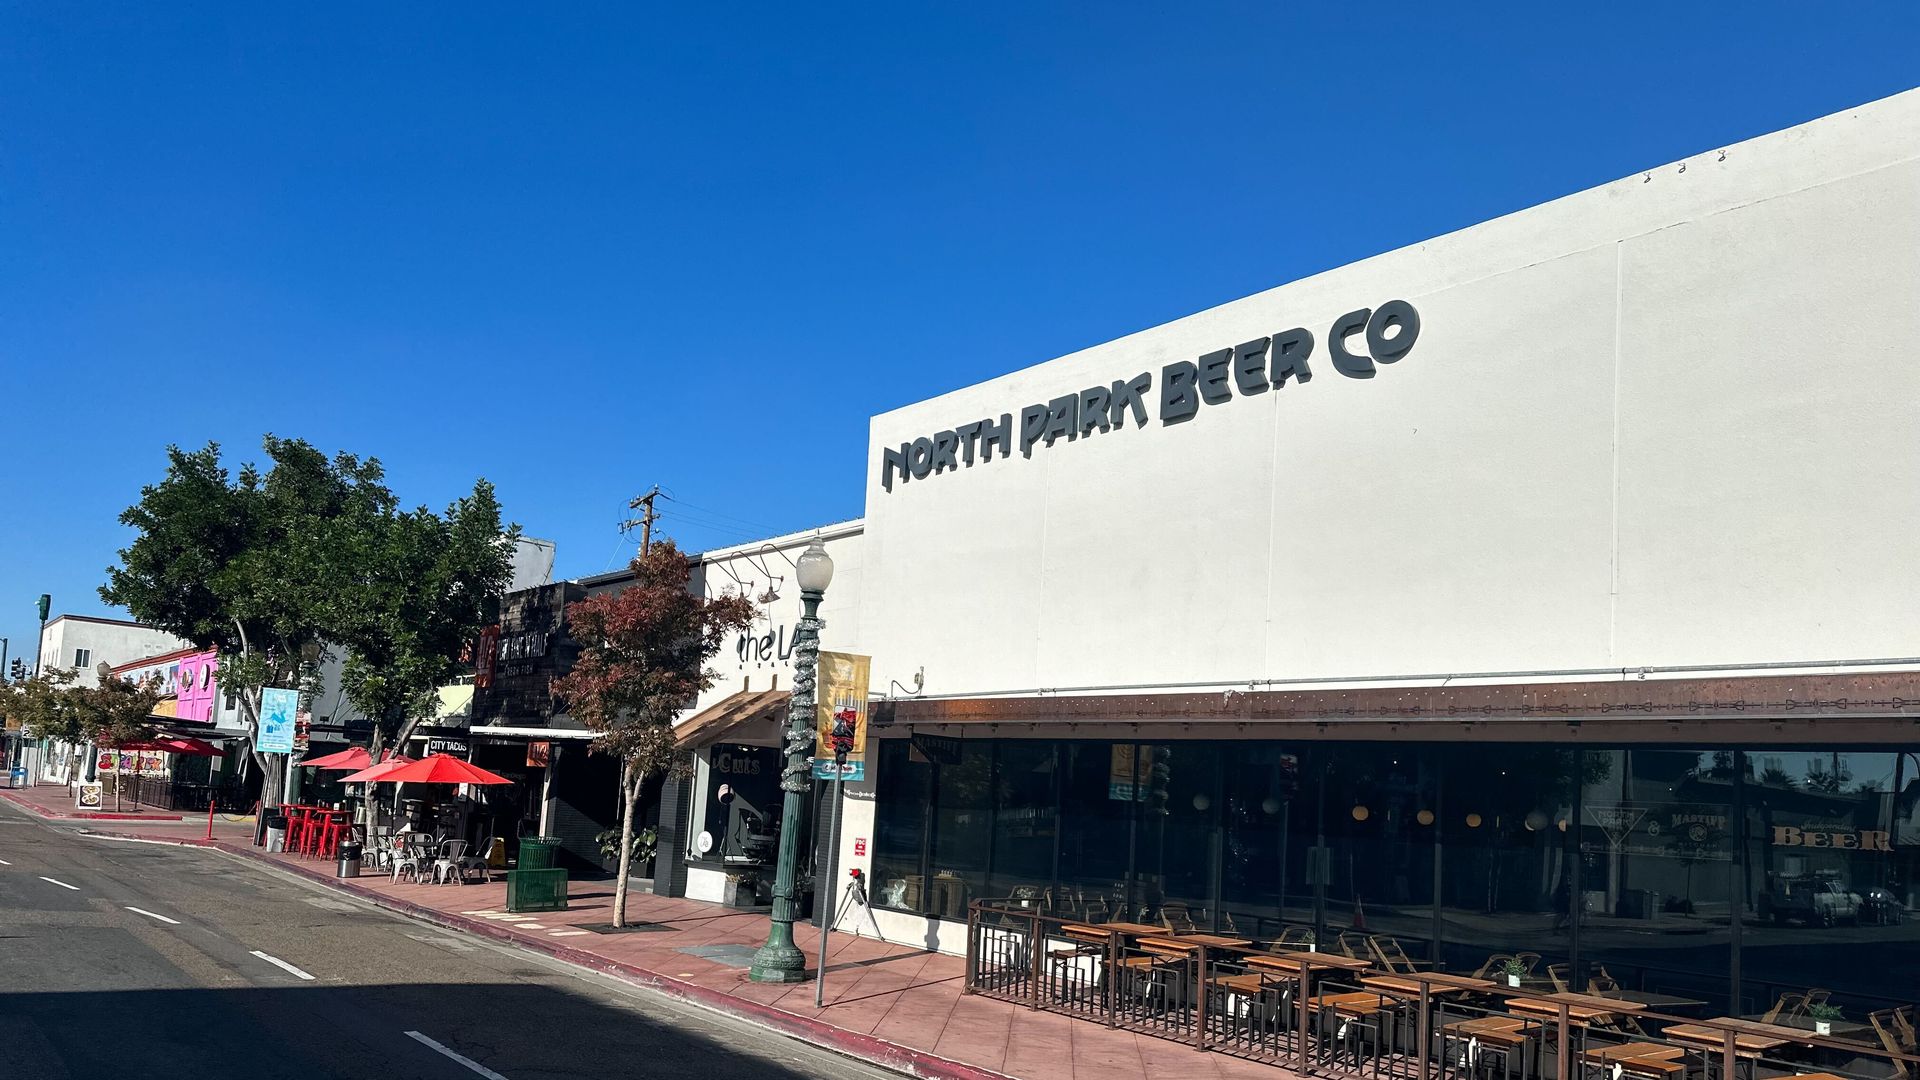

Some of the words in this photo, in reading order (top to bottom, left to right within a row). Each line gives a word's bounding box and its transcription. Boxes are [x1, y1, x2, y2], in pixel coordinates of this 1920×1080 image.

[882, 413, 1012, 493] NORTH
[1020, 371, 1151, 460] PARK
[1160, 327, 1314, 426] BEER
[1327, 299, 1420, 379] CO
[738, 627, 774, 663] the
[430, 740, 446, 750] CITY
[446, 741, 467, 752] TACOS
[719, 752, 761, 775] Cuts
[1771, 825, 1896, 851] BEER
